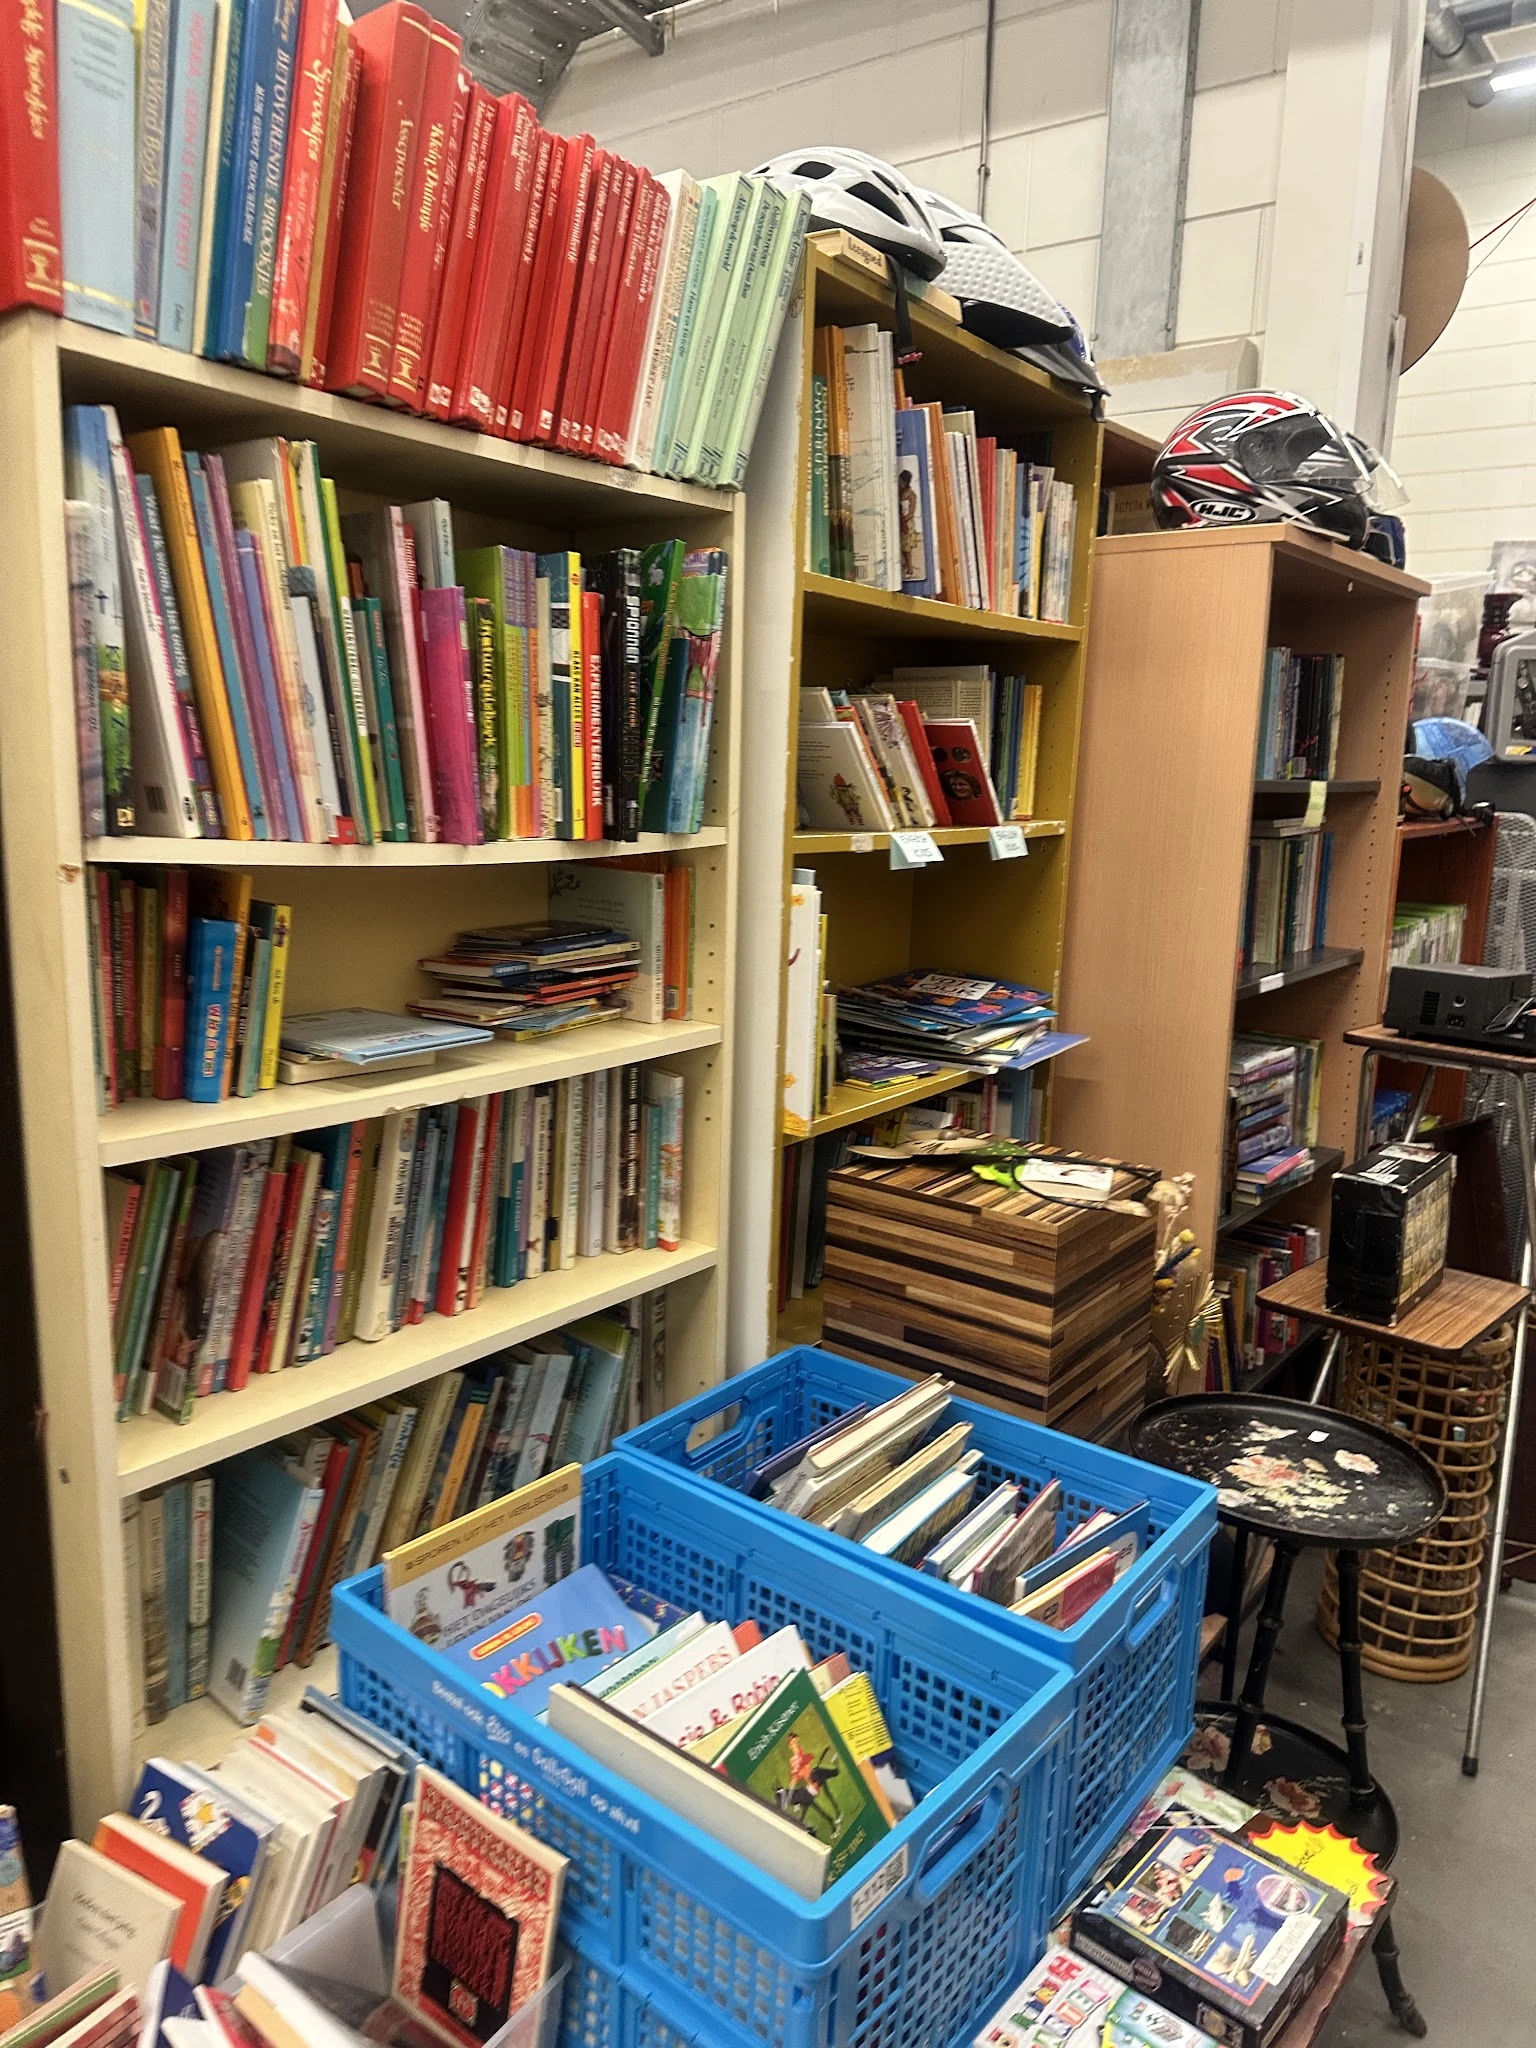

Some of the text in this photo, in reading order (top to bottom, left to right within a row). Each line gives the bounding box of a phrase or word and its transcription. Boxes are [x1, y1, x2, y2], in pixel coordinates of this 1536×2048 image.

[139, 0, 169, 188] Picture Word Book
[263, 47, 289, 189] BETOVERENDE
[297, 57, 326, 162] Sprookjes
[389, 117, 412, 211] Assepoester
[255, 192, 276, 298] SPROOKJES
[809, 382, 827, 474] OMNIBUS
[144, 495, 161, 531] Waar
[1197, 502, 1249, 521] HJC
[163, 596, 176, 607] is
[166, 610, 179, 630] het
[623, 595, 640, 664] SPIONNEN
[571, 651, 580, 674] KLAAS
[572, 677, 581, 693] KAN
[573, 695, 582, 718] ALLES
[586, 654, 606, 806] EXPERIMENTEERBOEK
[926, 973, 984, 989] VOTE
[629, 1067, 639, 1099] Hartman
[415, 1488, 561, 1566] SPOREN UIT HET VERLEDEN
[443, 1612, 471, 1637] HET
[463, 1705, 485, 1726] ook
[590, 1793, 609, 1813] op
